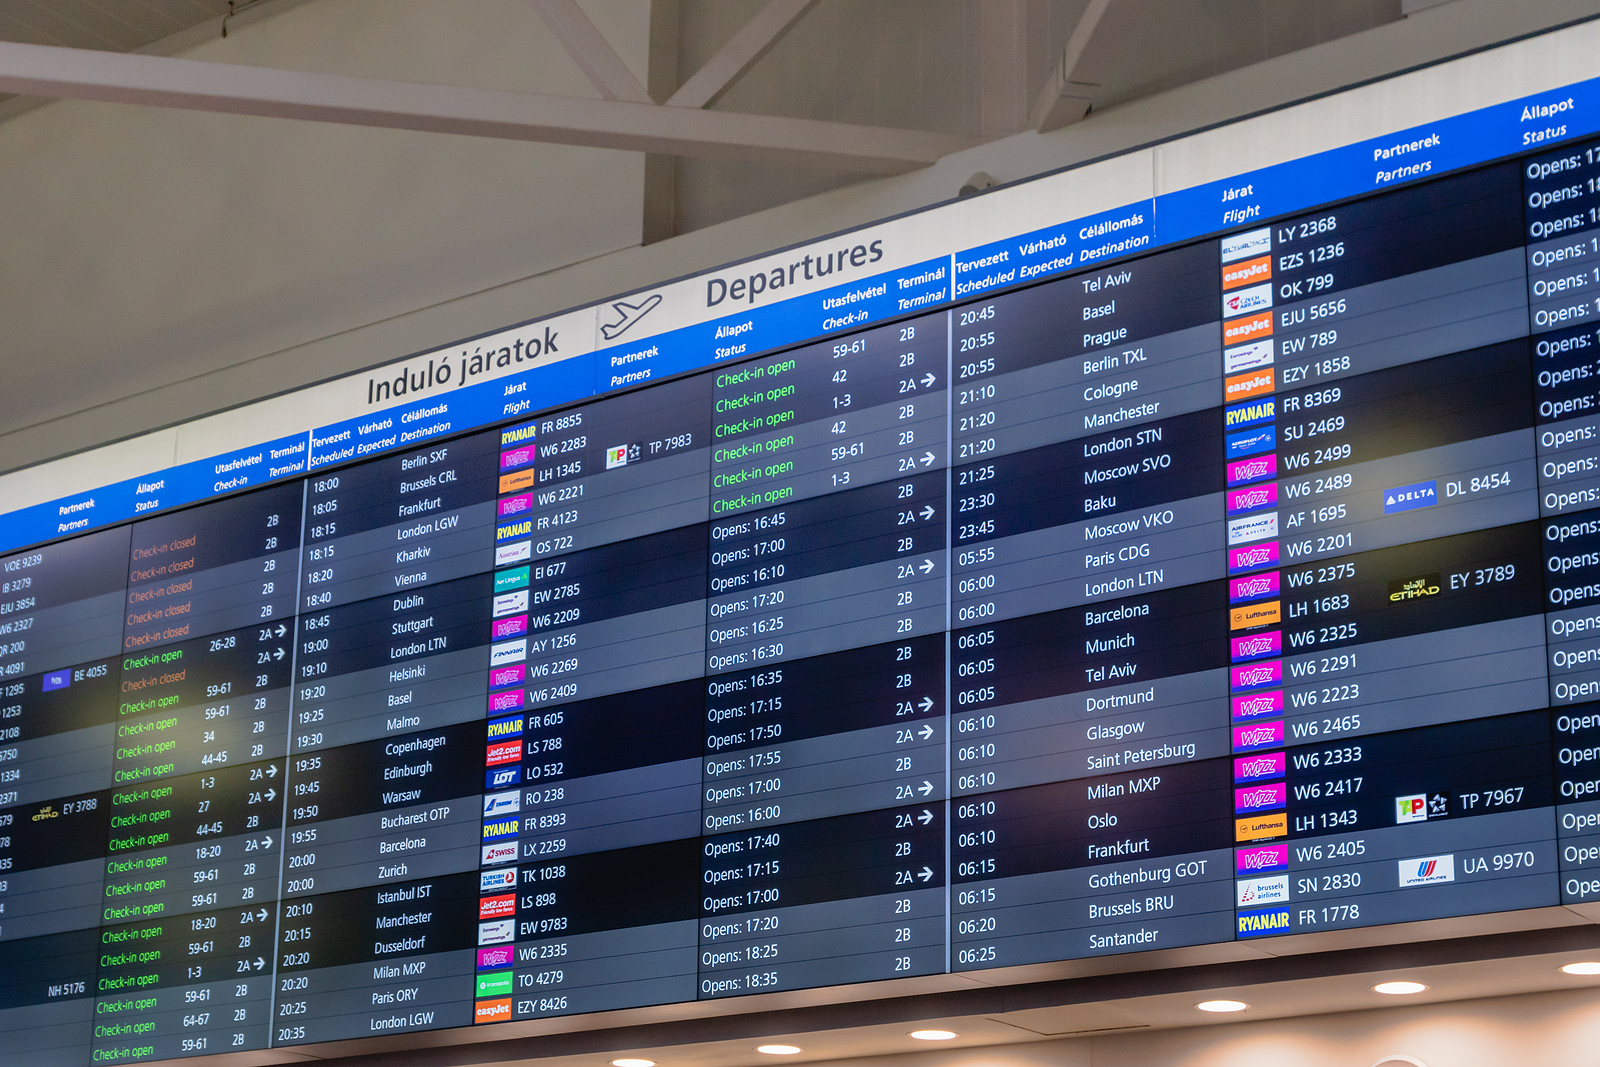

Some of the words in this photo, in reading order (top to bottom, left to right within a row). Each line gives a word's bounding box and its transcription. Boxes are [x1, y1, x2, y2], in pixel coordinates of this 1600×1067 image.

[1520, 97, 1574, 122] Állapot
[1522, 124, 1567, 145] Status
[1373, 132, 1441, 161] Partnerek
[1375, 160, 1432, 184] Partners
[1221, 184, 1254, 202] Járat
[1222, 204, 1261, 224] Flight
[1278, 225, 1296, 243] LY
[1300, 215, 1337, 238] 2368
[955, 250, 1009, 274] Tervezett
[1018, 233, 1067, 256] Várható
[1078, 213, 1144, 240] Célállomás
[706, 239, 884, 308] Departures
[956, 268, 1016, 295] Scheduled
[1019, 253, 1073, 279] Expected
[1079, 234, 1149, 262] Destination
[1224, 264, 1268, 281] easyJet
[822, 282, 887, 310] Utasfelvétel
[896, 266, 945, 290] Terminál
[1082, 276, 1101, 293] Tel
[1104, 270, 1132, 288] Aviv
[822, 309, 869, 330] Check-in
[897, 286, 946, 311] Terminal
[960, 305, 995, 326] 20:45
[1083, 299, 1115, 321] Basel
[714, 320, 753, 340] Állapot
[1083, 327, 1127, 347] Prague
[610, 345, 659, 367] Partnerek
[714, 343, 747, 360] Status
[1083, 355, 1119, 375] Berlin
[1122, 347, 1147, 365] TXL
[367, 356, 452, 405] Induló
[458, 326, 559, 387] járatok
[716, 367, 764, 388] Check-in
[767, 359, 795, 376] open
[610, 368, 651, 387] Partners
[503, 381, 527, 396] Járat
[1083, 379, 1138, 401] Cologne
[502, 399, 531, 415] Flight
[1084, 402, 1160, 429] Manchester
[310, 429, 351, 448] Tervezett
[357, 417, 393, 436] Várható
[400, 403, 448, 424] Célállomás
[541, 420, 554, 434] FR
[555, 413, 582, 430] 8855
[310, 445, 355, 468] Scheduled
[356, 434, 397, 454] Expected
[400, 421, 451, 443] Destination
[501, 425, 536, 445] RYANAIR
[1084, 437, 1132, 457] London
[1136, 427, 1162, 445] STN
[214, 452, 262, 474] Utasfelvétel
[269, 441, 305, 459] Terminál
[401, 455, 428, 471] Berlin
[429, 448, 448, 464] SXF
[213, 476, 248, 492] Check-in
[269, 459, 305, 477] Terminal
[1084, 463, 1139, 485] Moscow
[1142, 454, 1171, 472] SVO
[135, 479, 165, 495] Állapot
[314, 477, 339, 493] 18:00
[400, 474, 436, 494] Brussels
[438, 469, 457, 484] CRL
[1446, 480, 1467, 497] DL
[1470, 471, 1511, 492] 8454
[1084, 495, 1116, 513] Baku
[1397, 487, 1435, 502] DELTA
[58, 498, 95, 516] Partnerek
[134, 499, 159, 513] Status
[398, 496, 441, 517] Frankfurt
[57, 518, 89, 533] Partners
[266, 514, 279, 527] 2B
[397, 523, 432, 540] London
[434, 515, 459, 531] LGW
[1085, 519, 1140, 540] Moscow
[1142, 510, 1174, 528] VKO
[132, 544, 168, 560] Check-in
[169, 534, 196, 551] closed
[396, 546, 431, 563] Kharkiv
[1085, 551, 1115, 568] Paris
[1118, 543, 1150, 561] CDG
[4, 559, 21, 572] VOE
[22, 553, 42, 568] 9239
[394, 571, 427, 587] Vienna
[1085, 577, 1134, 597] London
[1138, 568, 1163, 587] LTN
[393, 595, 424, 611] Dublin
[1085, 604, 1149, 626] Barcelona
[391, 616, 433, 635] Stuttgart
[209, 636, 236, 652] 26-28
[390, 642, 426, 659] London
[428, 636, 447, 651] LTN
[1086, 632, 1135, 654] Munich
[74, 669, 85, 682] BE
[85, 664, 107, 678] 4055
[389, 665, 426, 682] Helsinki
[1085, 666, 1105, 683] Tel
[1108, 662, 1137, 679] Aviv
[388, 690, 412, 707] Basel
[1086, 686, 1154, 712] Dortmund
[386, 715, 420, 731] Malmo
[1086, 721, 1145, 740] Glasgow
[385, 736, 446, 756] Copenhagen
[295, 756, 321, 772] 19:35
[1087, 752, 1121, 770] Saint
[1124, 743, 1195, 764] Petersburg
[384, 760, 432, 780] Edinburgh
[382, 789, 421, 804] Warsaw
[1087, 783, 1124, 800] Milan
[1129, 776, 1161, 794] MXP
[63, 802, 75, 815] EY
[75, 798, 97, 813] 3788
[381, 811, 428, 829] Bucharest
[429, 806, 450, 821] OTP
[1087, 812, 1118, 829] Oslo
[379, 837, 426, 854] Barcelona
[1088, 838, 1150, 859] Frankfurt
[378, 862, 407, 879] Zurich
[1463, 857, 1489, 874] UA
[1493, 851, 1534, 871] 9970
[521, 869, 536, 883] TK
[539, 865, 566, 881] 1038
[1088, 867, 1171, 888] Gothenburg
[1175, 859, 1208, 877] GOT
[1297, 877, 1318, 894] SN
[1322, 872, 1361, 891] 2830
[377, 886, 415, 904] Istanbul
[416, 884, 432, 898] IST
[1089, 898, 1142, 919] Brussels
[1145, 894, 1174, 912] BRU
[375, 912, 432, 929] Manchester
[1238, 911, 1290, 932] RYANAIR
[102, 929, 139, 944] Check-in
[140, 926, 162, 940] open
[374, 935, 426, 954] Dusseldorf
[1089, 928, 1159, 949] Santander
[958, 946, 996, 964] 06:25
[373, 965, 400, 980] Milan
[402, 961, 426, 976] MXP
[47, 984, 62, 997] NH
[62, 981, 85, 995] 5176
[701, 979, 741, 996] Opens:
[745, 971, 778, 988] 18:35
[372, 992, 394, 1005] Paris
[396, 987, 419, 1002] ORY
[517, 999, 538, 1014] EZY
[539, 996, 567, 1011] 8426
[183, 1012, 210, 1027] 64-67
[370, 1015, 407, 1031] London
[409, 1011, 434, 1026] LGW
[278, 1026, 305, 1041] 20:35
[181, 1037, 207, 1052] 59-61
